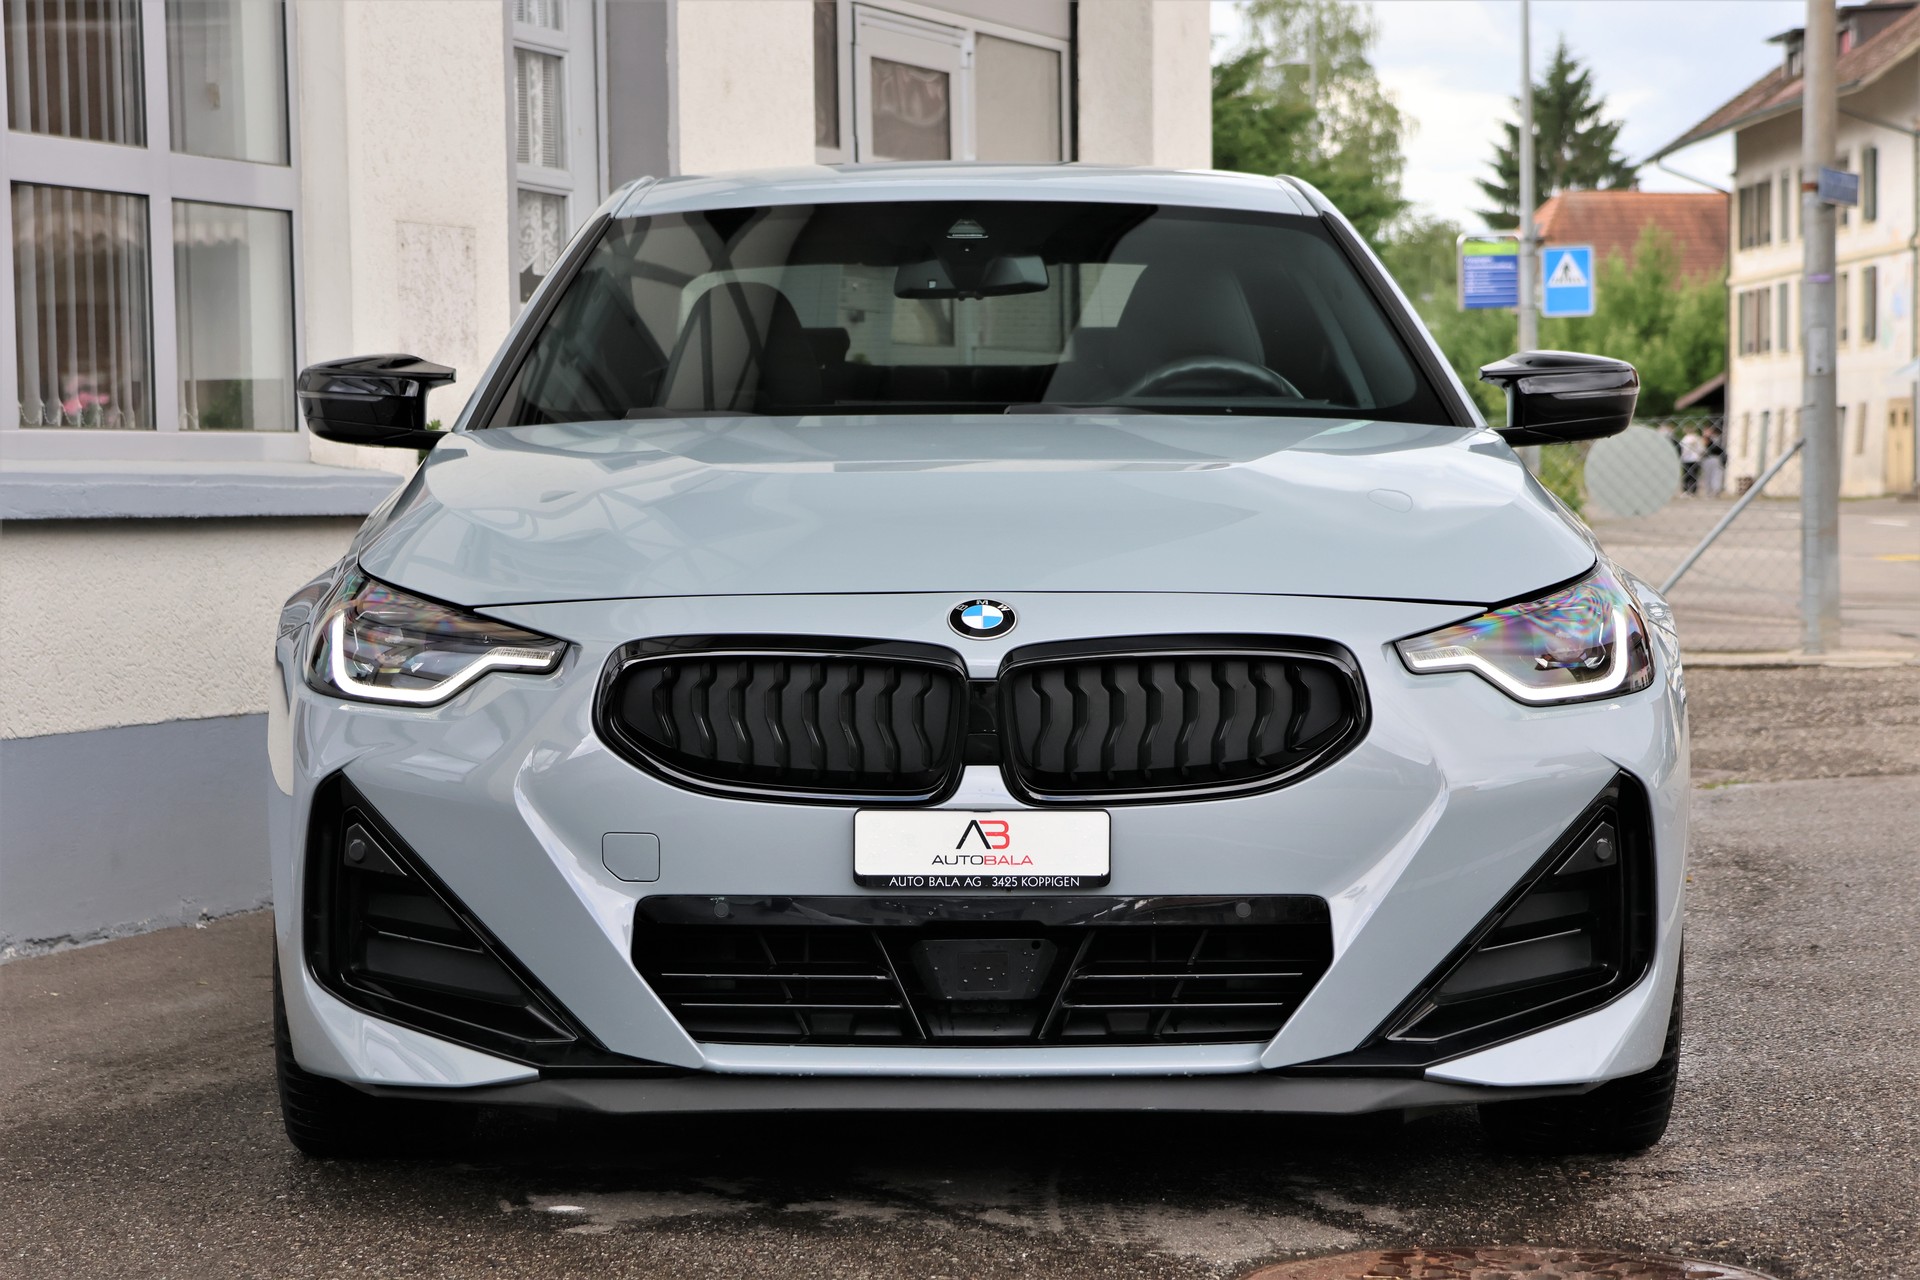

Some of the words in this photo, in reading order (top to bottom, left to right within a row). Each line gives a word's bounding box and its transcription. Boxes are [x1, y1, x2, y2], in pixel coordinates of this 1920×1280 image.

[955, 599, 1010, 611] BMW
[931, 854, 1034, 866] AUTOBALA
[889, 876, 924, 887] AUTO
[928, 876, 960, 887] BALA
[963, 876, 982, 888] AG
[991, 876, 1018, 887] 3425
[1021, 876, 1081, 887] KOPPIGEN
